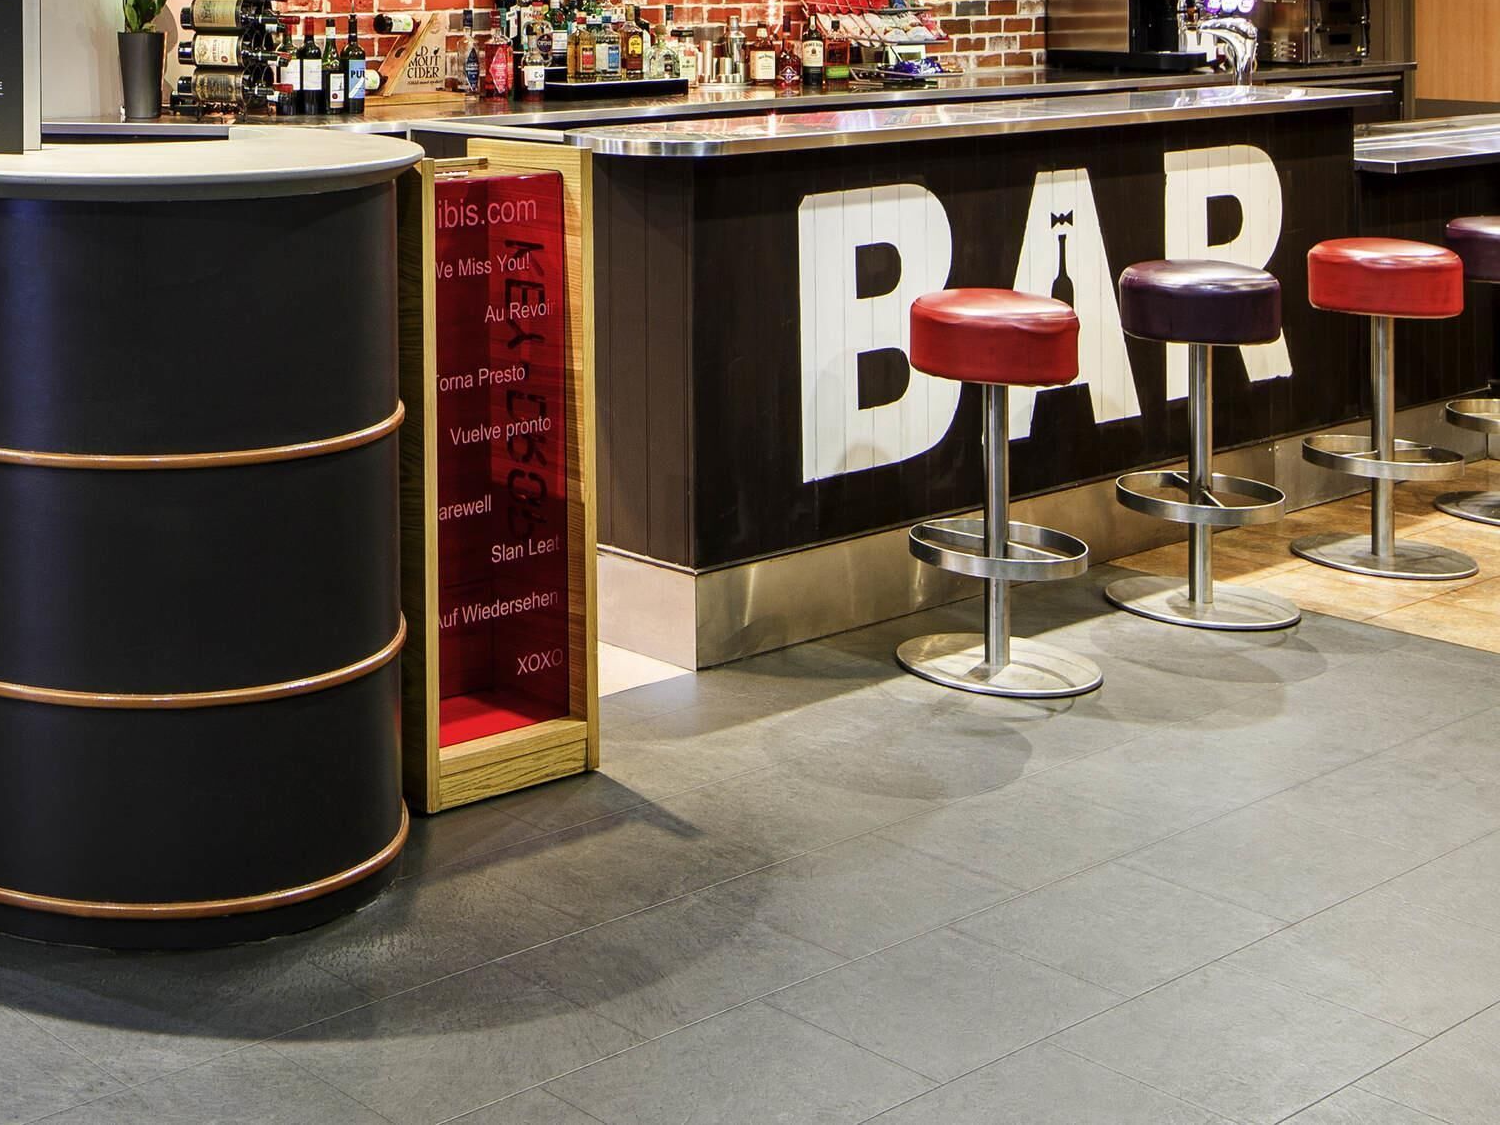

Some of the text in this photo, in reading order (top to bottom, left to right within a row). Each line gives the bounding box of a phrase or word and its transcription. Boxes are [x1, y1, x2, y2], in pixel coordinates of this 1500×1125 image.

[406, 66, 440, 79] CIDER
[438, 198, 537, 229] ibis.com
[458, 257, 493, 276] Miss
[496, 251, 531, 273] You!
[484, 304, 505, 324] Au
[798, 144, 1293, 484] BAR
[436, 364, 526, 392] orna Presto
[450, 415, 552, 446] Vuelve pronto
[437, 493, 492, 521] arewell
[491, 542, 524, 563] Slan
[461, 590, 558, 625] Wiedersehen
[517, 648, 563, 676] XOXO
